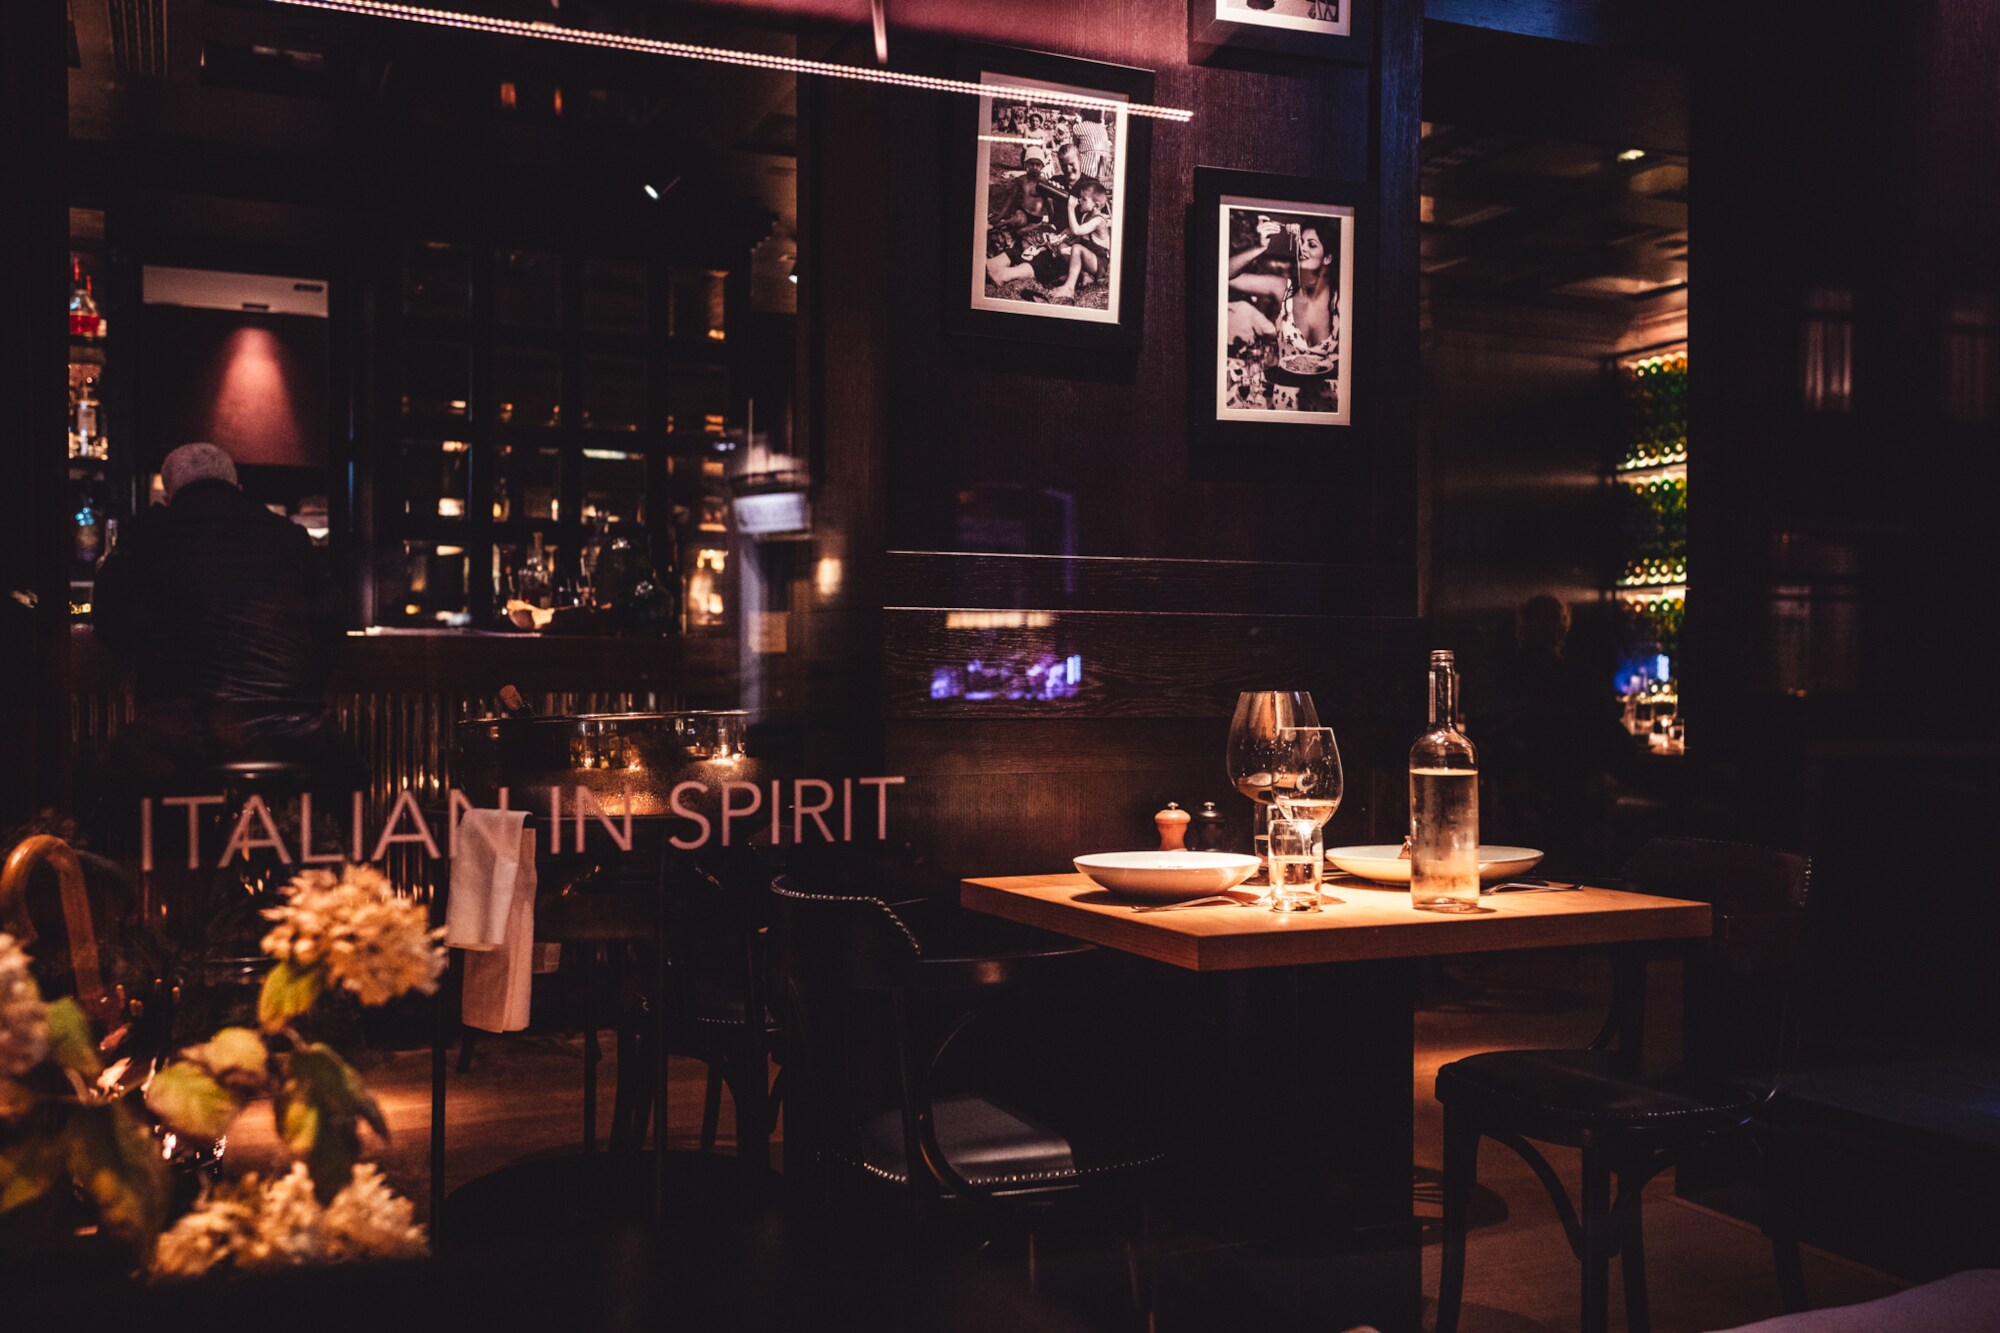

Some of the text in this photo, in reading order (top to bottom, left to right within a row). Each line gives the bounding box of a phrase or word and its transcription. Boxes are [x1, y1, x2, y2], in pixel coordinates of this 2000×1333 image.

[140, 775, 906, 873] ITALIAN IN SPIRIT
